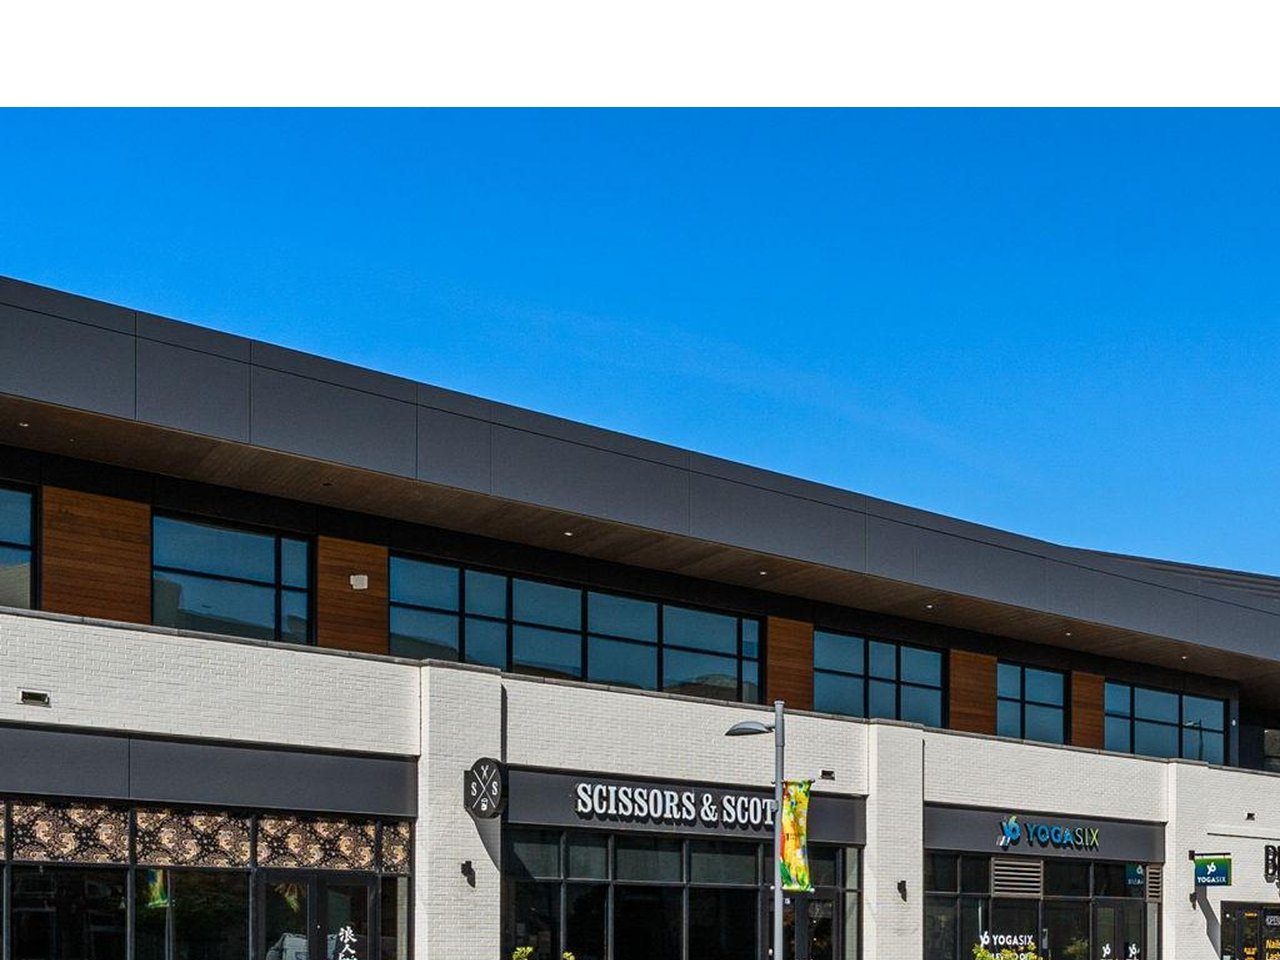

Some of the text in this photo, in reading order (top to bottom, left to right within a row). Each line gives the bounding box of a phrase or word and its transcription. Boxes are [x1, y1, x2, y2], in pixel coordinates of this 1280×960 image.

[576, 783, 696, 821] SCISSORS
[700, 793, 719, 823] &
[1025, 822, 1100, 847] YOGASIX
[1197, 876, 1227, 884] YOGASIX
[992, 934, 1034, 946] YOGASIX
